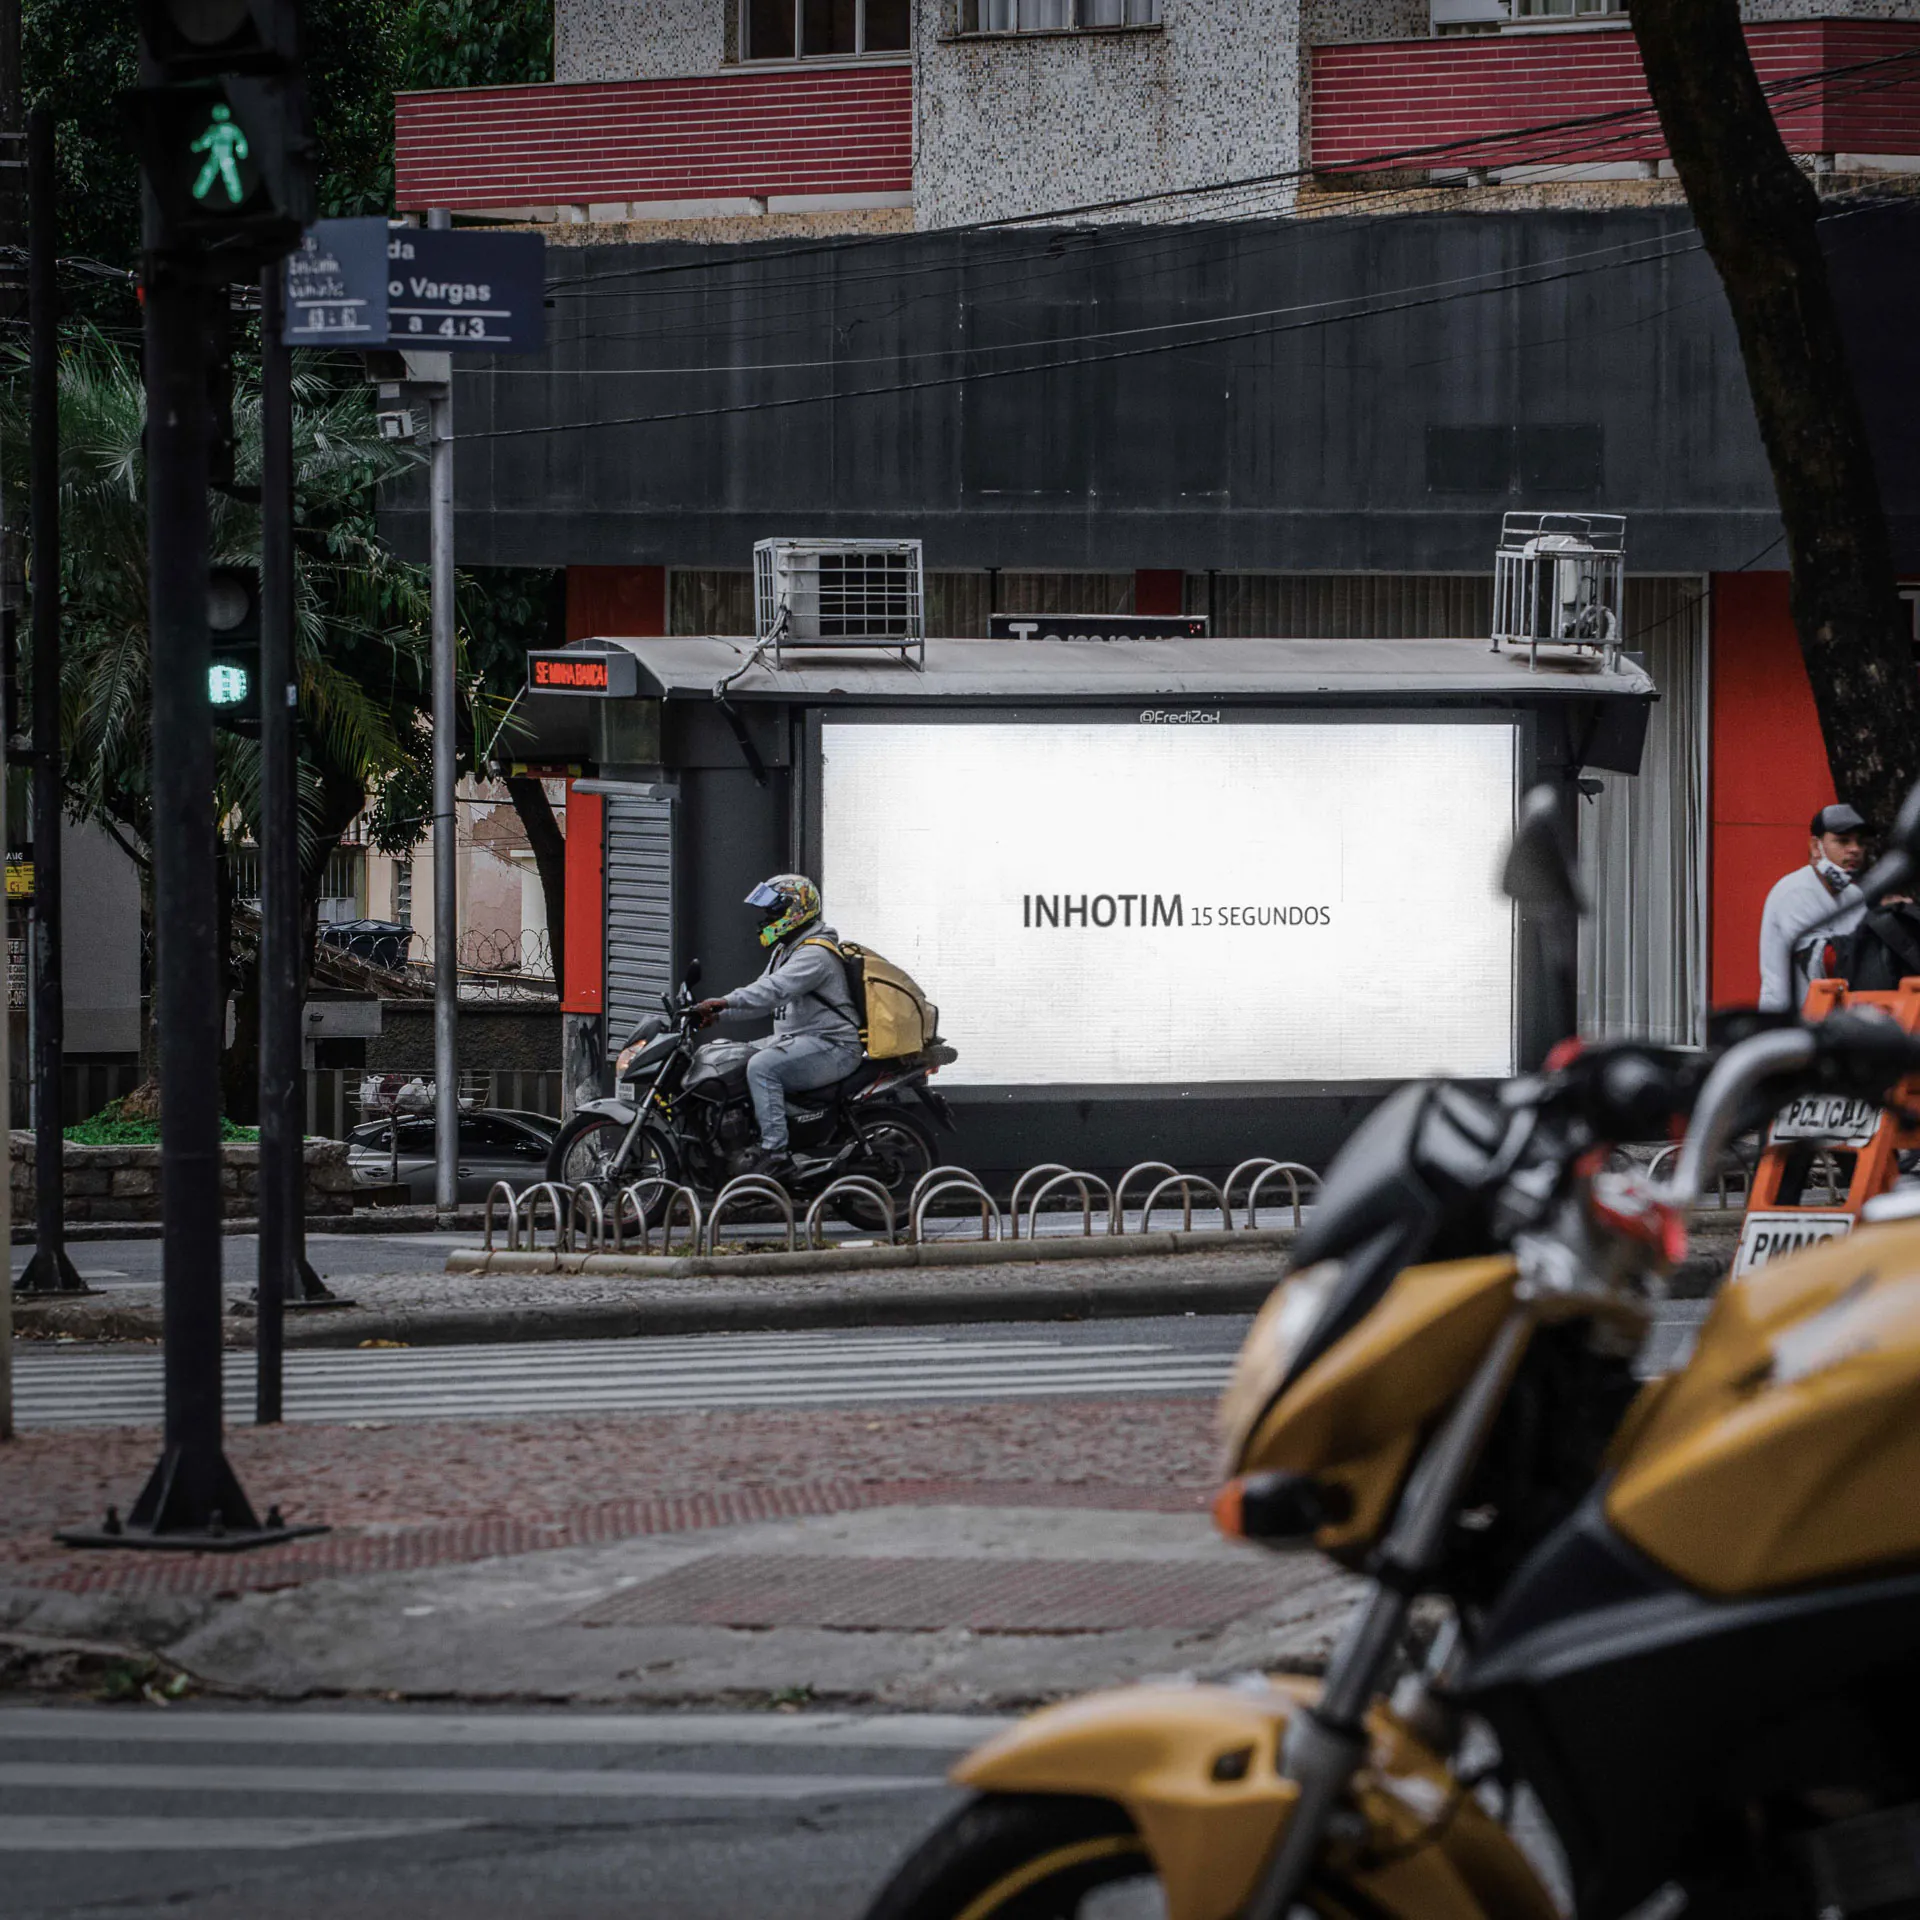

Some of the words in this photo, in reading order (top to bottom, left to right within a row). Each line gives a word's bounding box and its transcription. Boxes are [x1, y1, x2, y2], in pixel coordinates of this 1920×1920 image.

[410, 277, 491, 304] Vargas
[1023, 894, 1183, 928] INHOTIM
[1191, 906, 1212, 926] 15
[1218, 906, 1331, 926] SEGUNDOS
